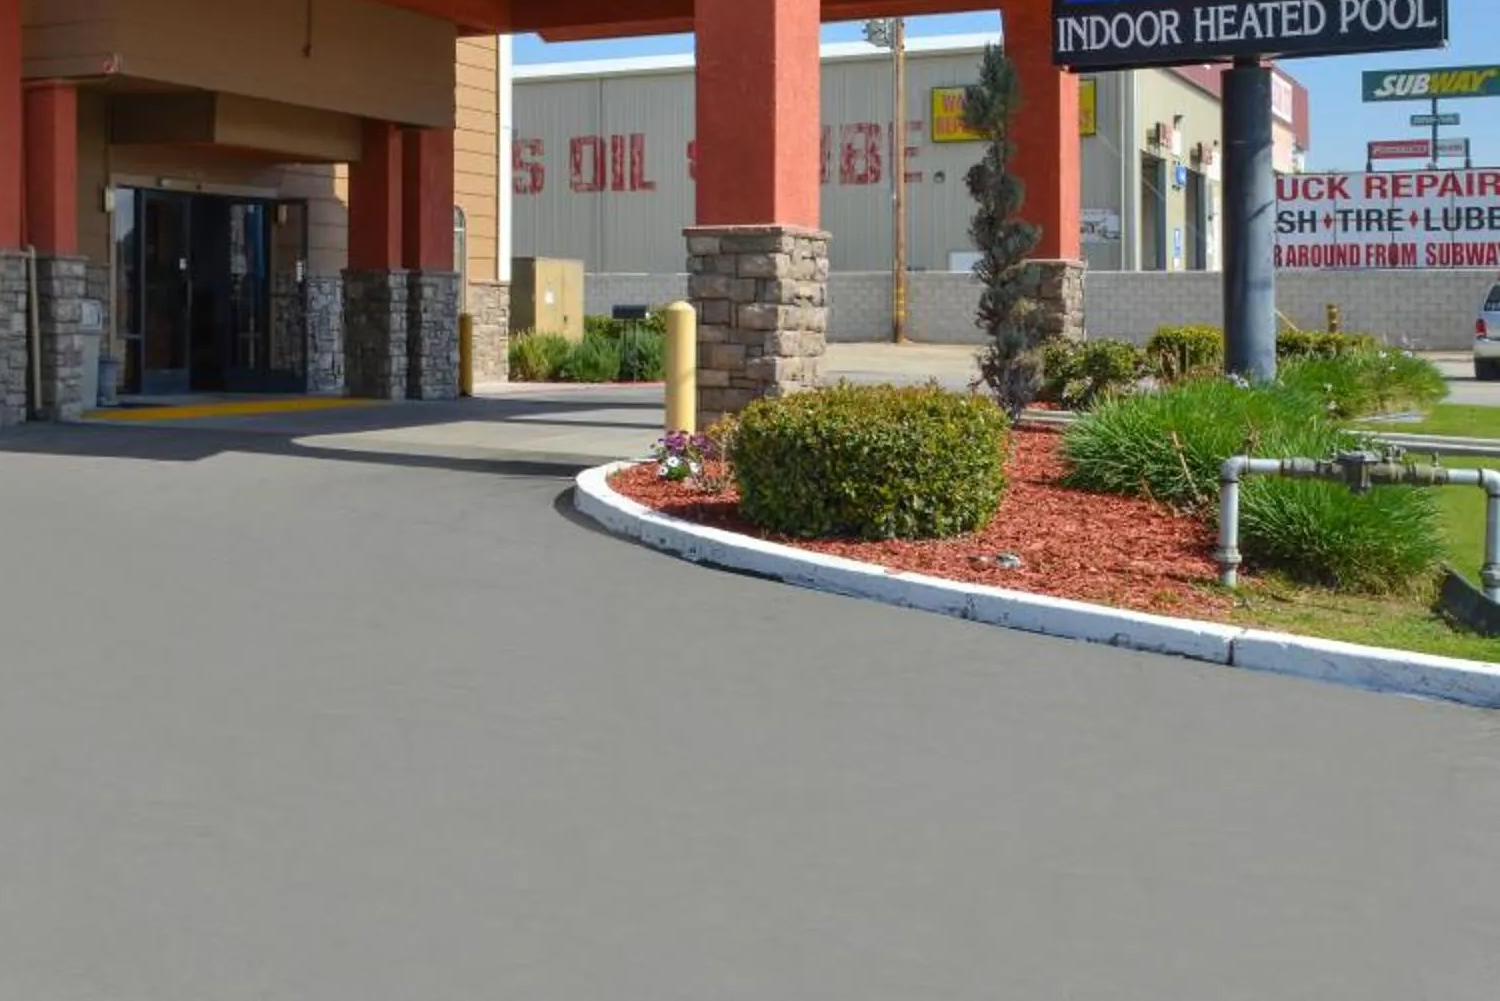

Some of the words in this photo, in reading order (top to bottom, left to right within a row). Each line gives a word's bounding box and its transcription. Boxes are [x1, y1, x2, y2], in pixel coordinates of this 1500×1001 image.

[1057, 9, 1182, 52] INDOOR
[1373, 69, 1489, 98] SUBWAY
[569, 132, 657, 193] OIL
[1276, 176, 1351, 202] UCK
[1364, 172, 1500, 200] REPAIR
[1276, 210, 1317, 234] SH
[1337, 208, 1404, 232] TIRE
[1423, 206, 1500, 232] LUBE
[1286, 243, 1360, 268] AROUND
[1365, 242, 1418, 267] FROM
